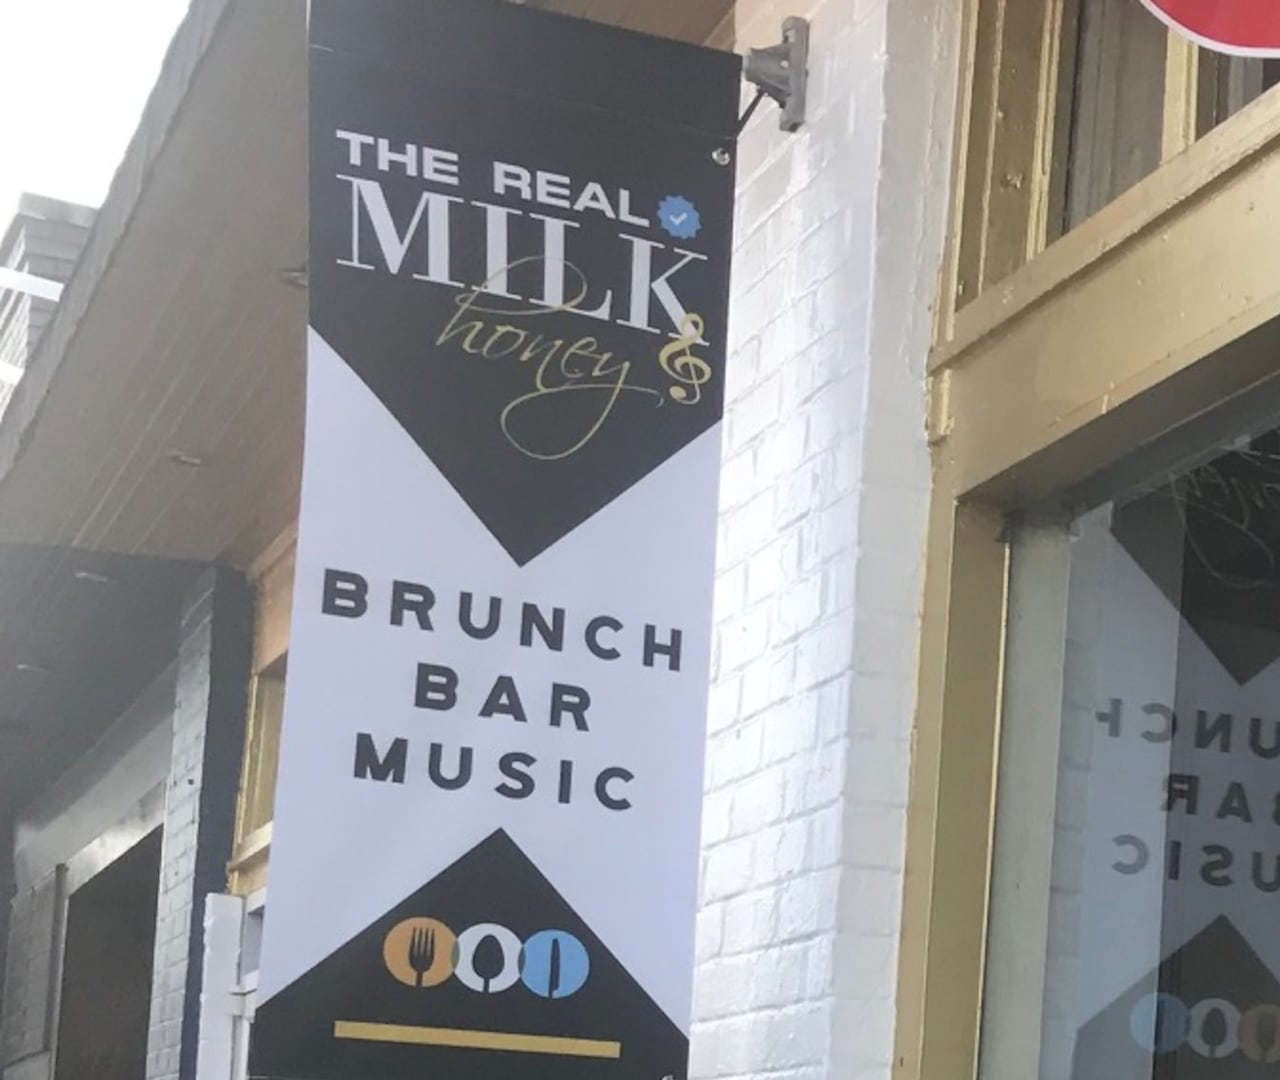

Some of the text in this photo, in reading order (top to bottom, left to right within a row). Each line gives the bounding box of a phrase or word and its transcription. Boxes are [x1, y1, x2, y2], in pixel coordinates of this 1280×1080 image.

[336, 129, 650, 228] THE REAL
[335, 173, 711, 347] MILK
[436, 254, 665, 460] honey
[320, 568, 684, 672] BRUNCH
[413, 663, 592, 732] BAR
[352, 732, 636, 810] MUSIC
